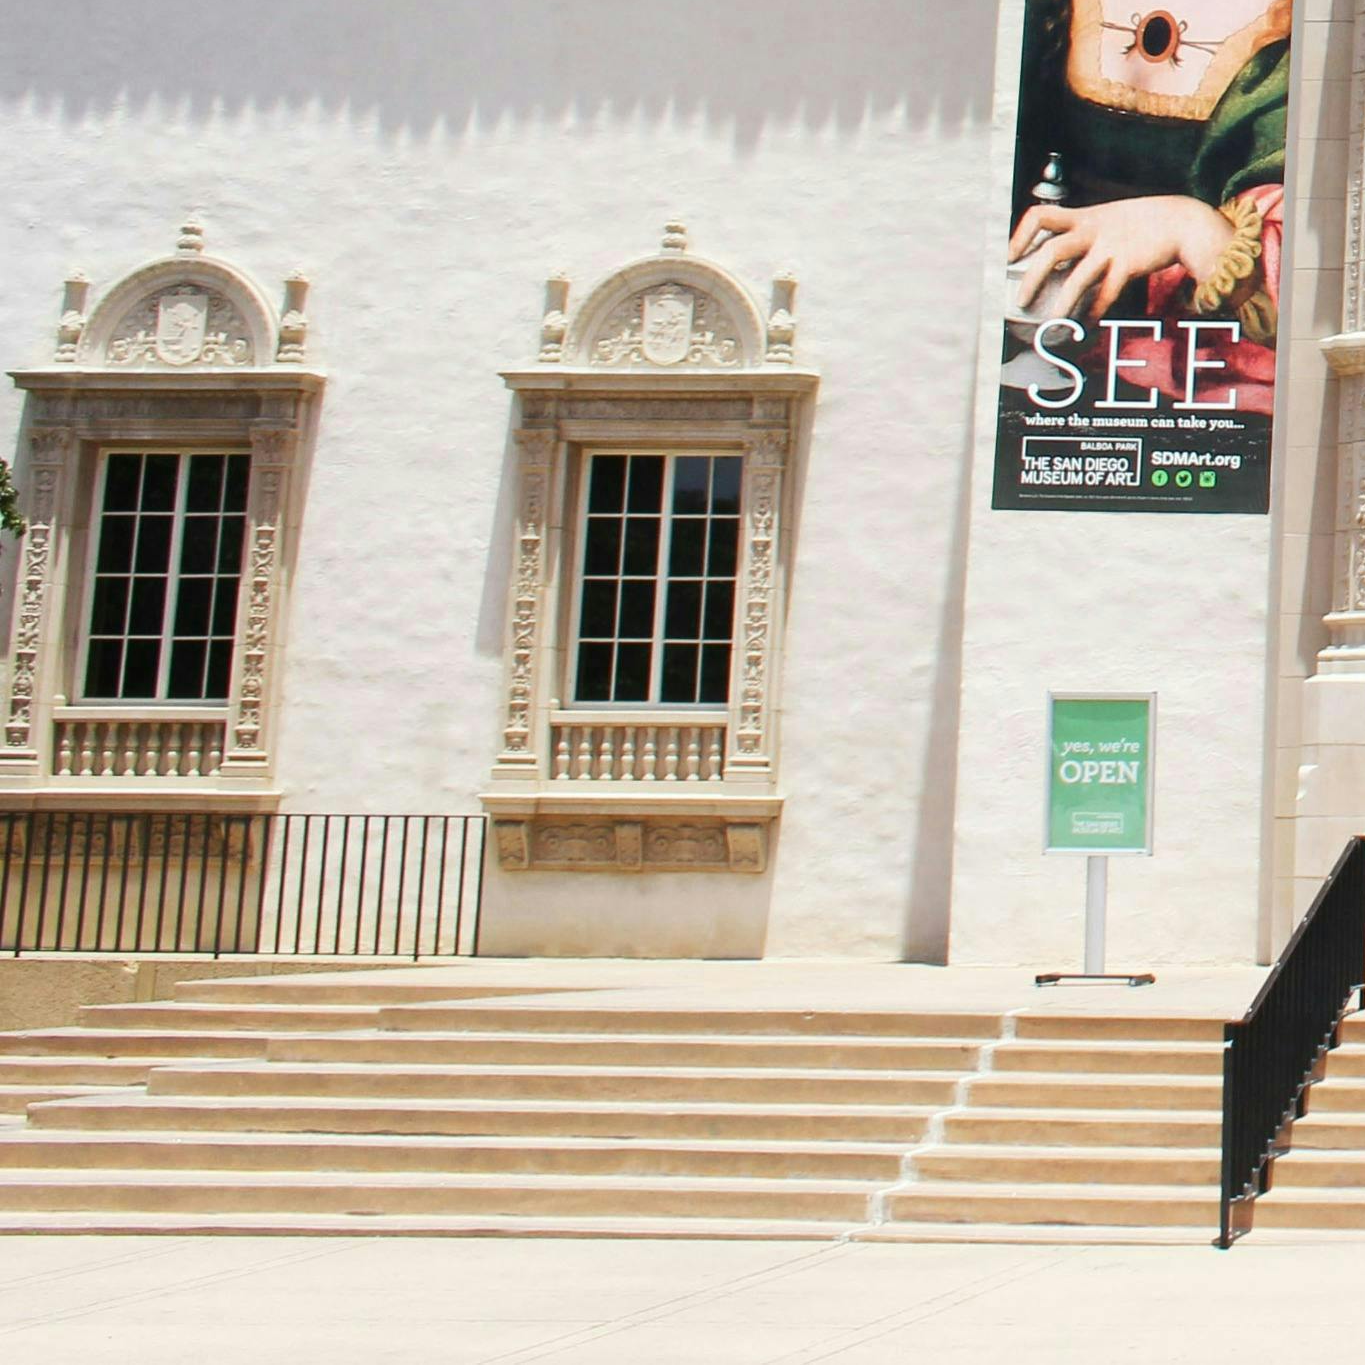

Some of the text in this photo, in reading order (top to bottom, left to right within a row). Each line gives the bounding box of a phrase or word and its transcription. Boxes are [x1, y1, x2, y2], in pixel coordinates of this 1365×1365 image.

[1027, 318, 1240, 411] SEE
[1025, 413, 1245, 431] where the museum can take you...
[1080, 442, 1138, 452] BALBOA PARK
[1023, 456, 1129, 472] THE SAN DIEGO
[1151, 451, 1241, 469] SDMArt.org
[1020, 471, 1134, 486] MUSEUM OF ART
[1061, 740, 1095, 756] yes,
[1059, 760, 1140, 784] OPEN
